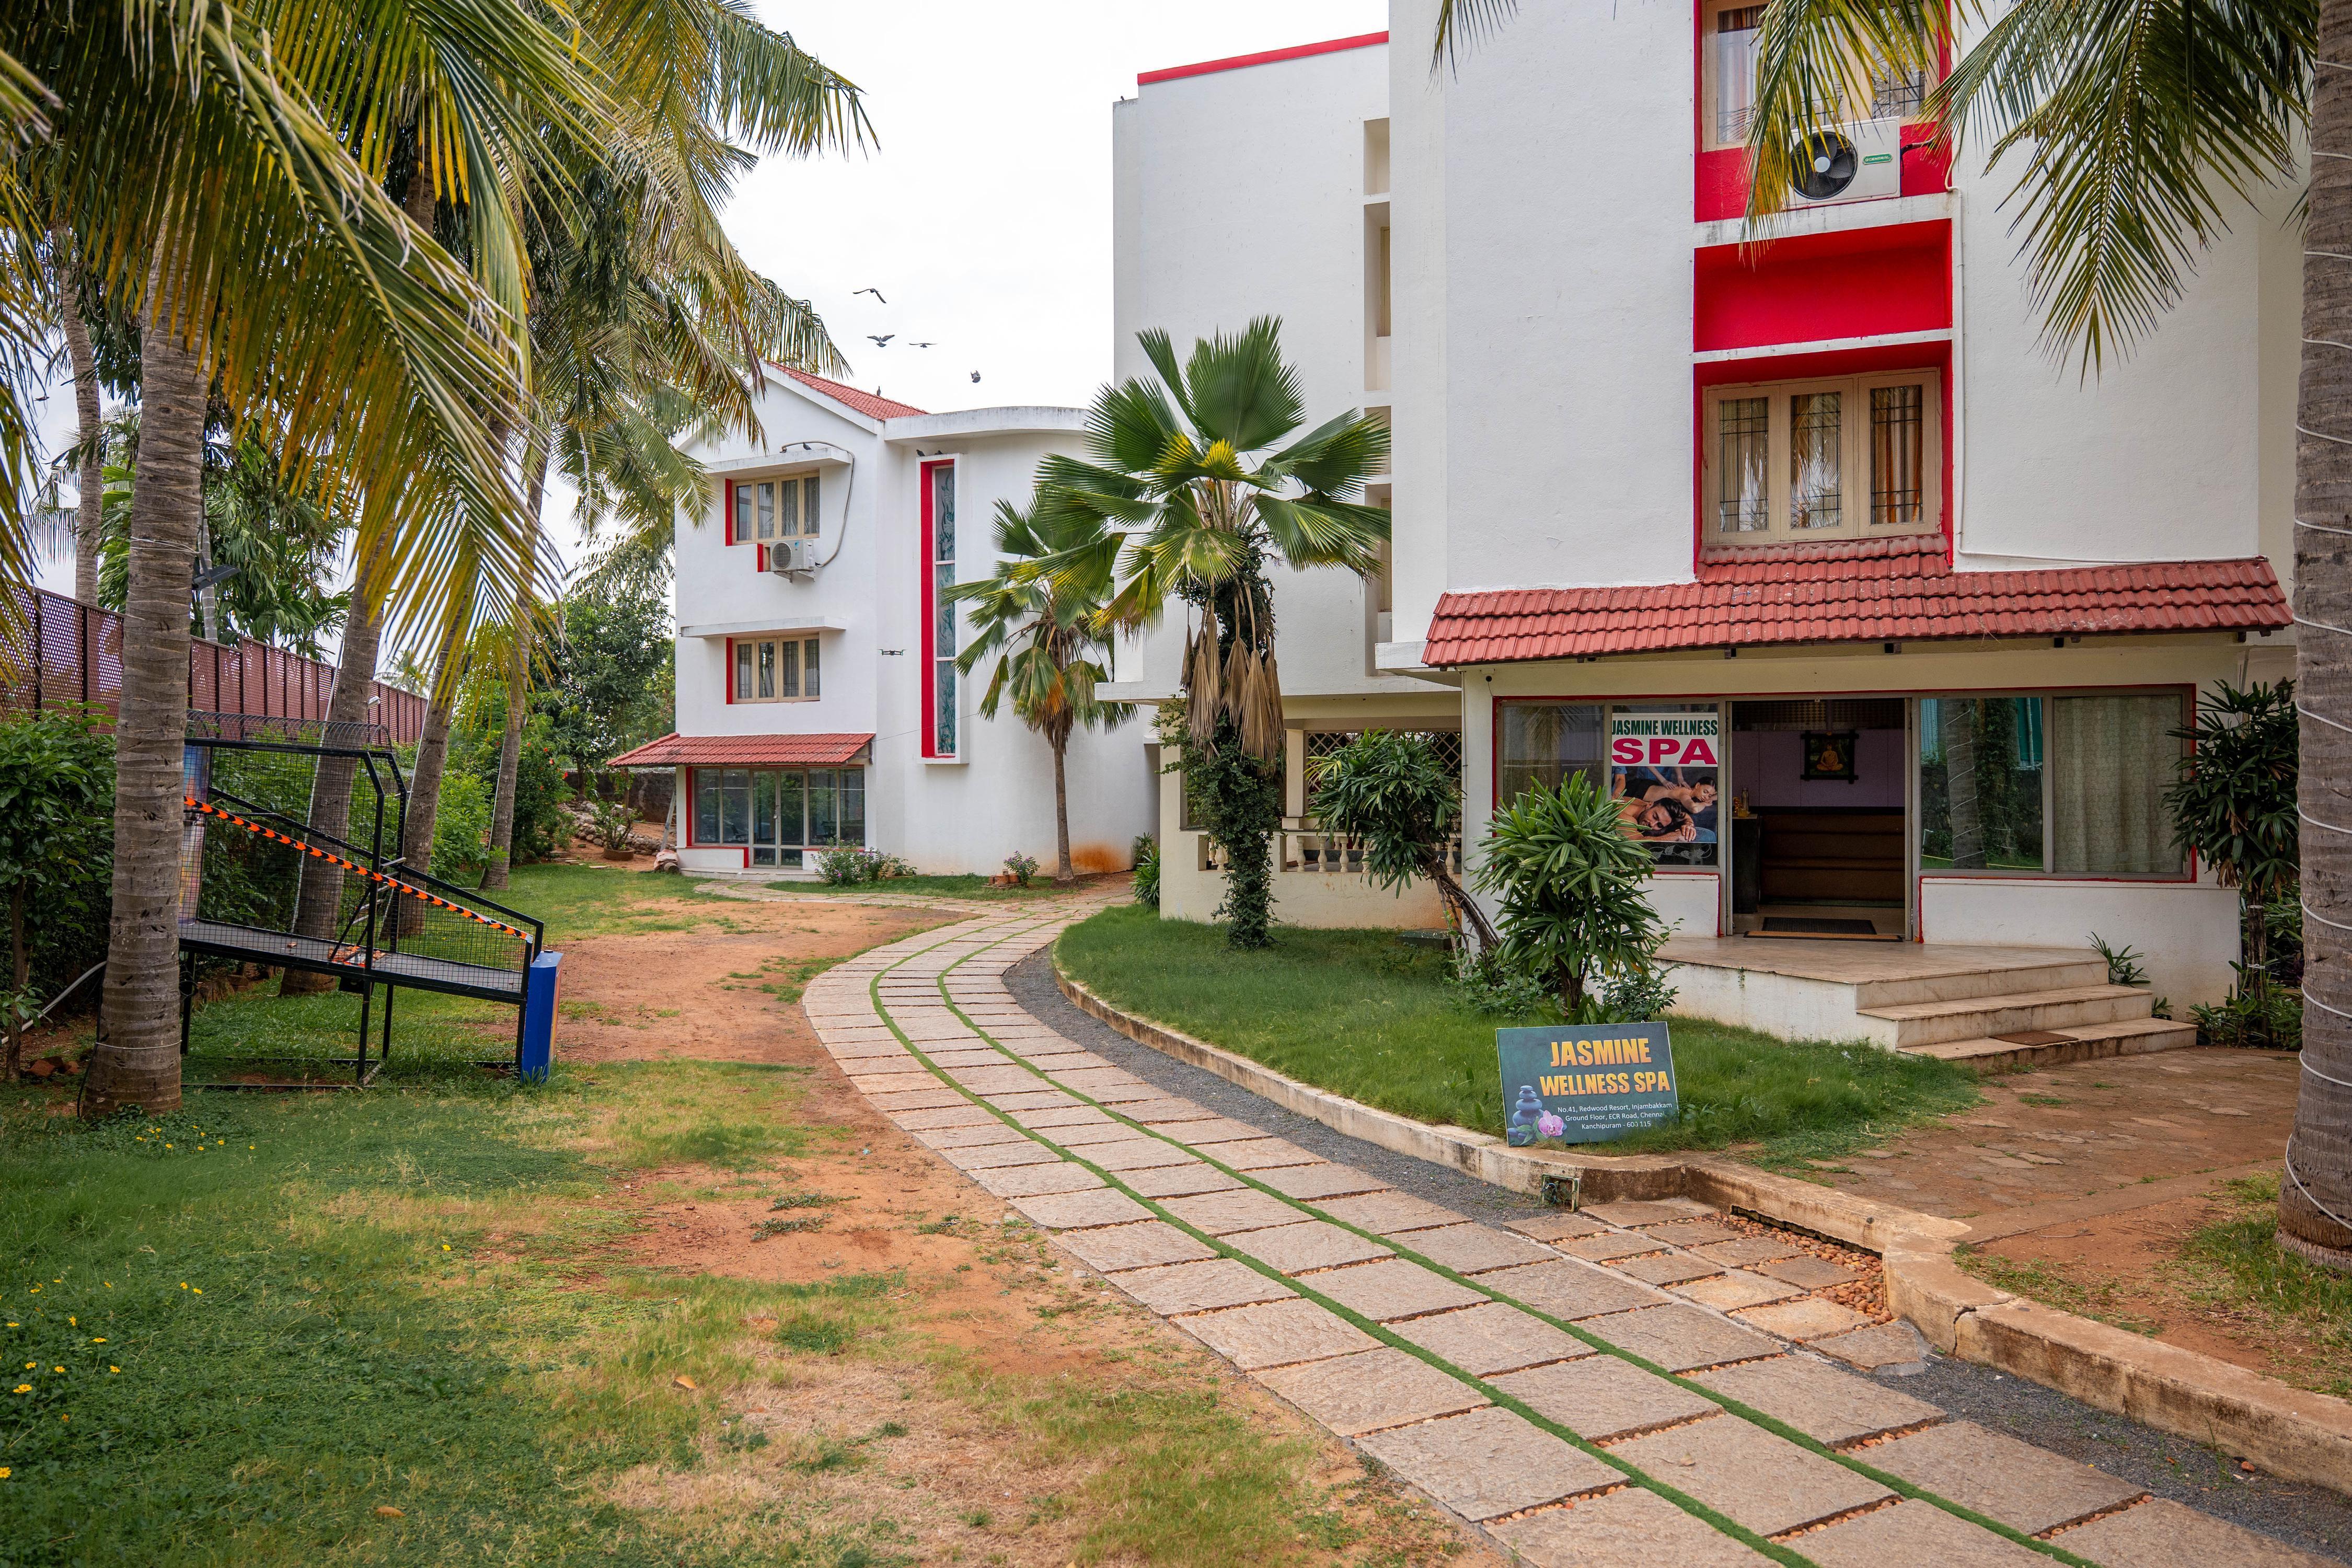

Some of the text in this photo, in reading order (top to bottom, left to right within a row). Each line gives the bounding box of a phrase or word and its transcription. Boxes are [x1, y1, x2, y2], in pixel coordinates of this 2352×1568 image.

[1612, 720, 1717, 735] JASMINE WELLNESS
[1612, 738, 1717, 764] SPA
[1550, 1037, 1652, 1067] JASMINE
[1539, 1071, 1671, 1096] WELLNESS SPA
[1632, 1102, 1672, 1111] Injambakkam
